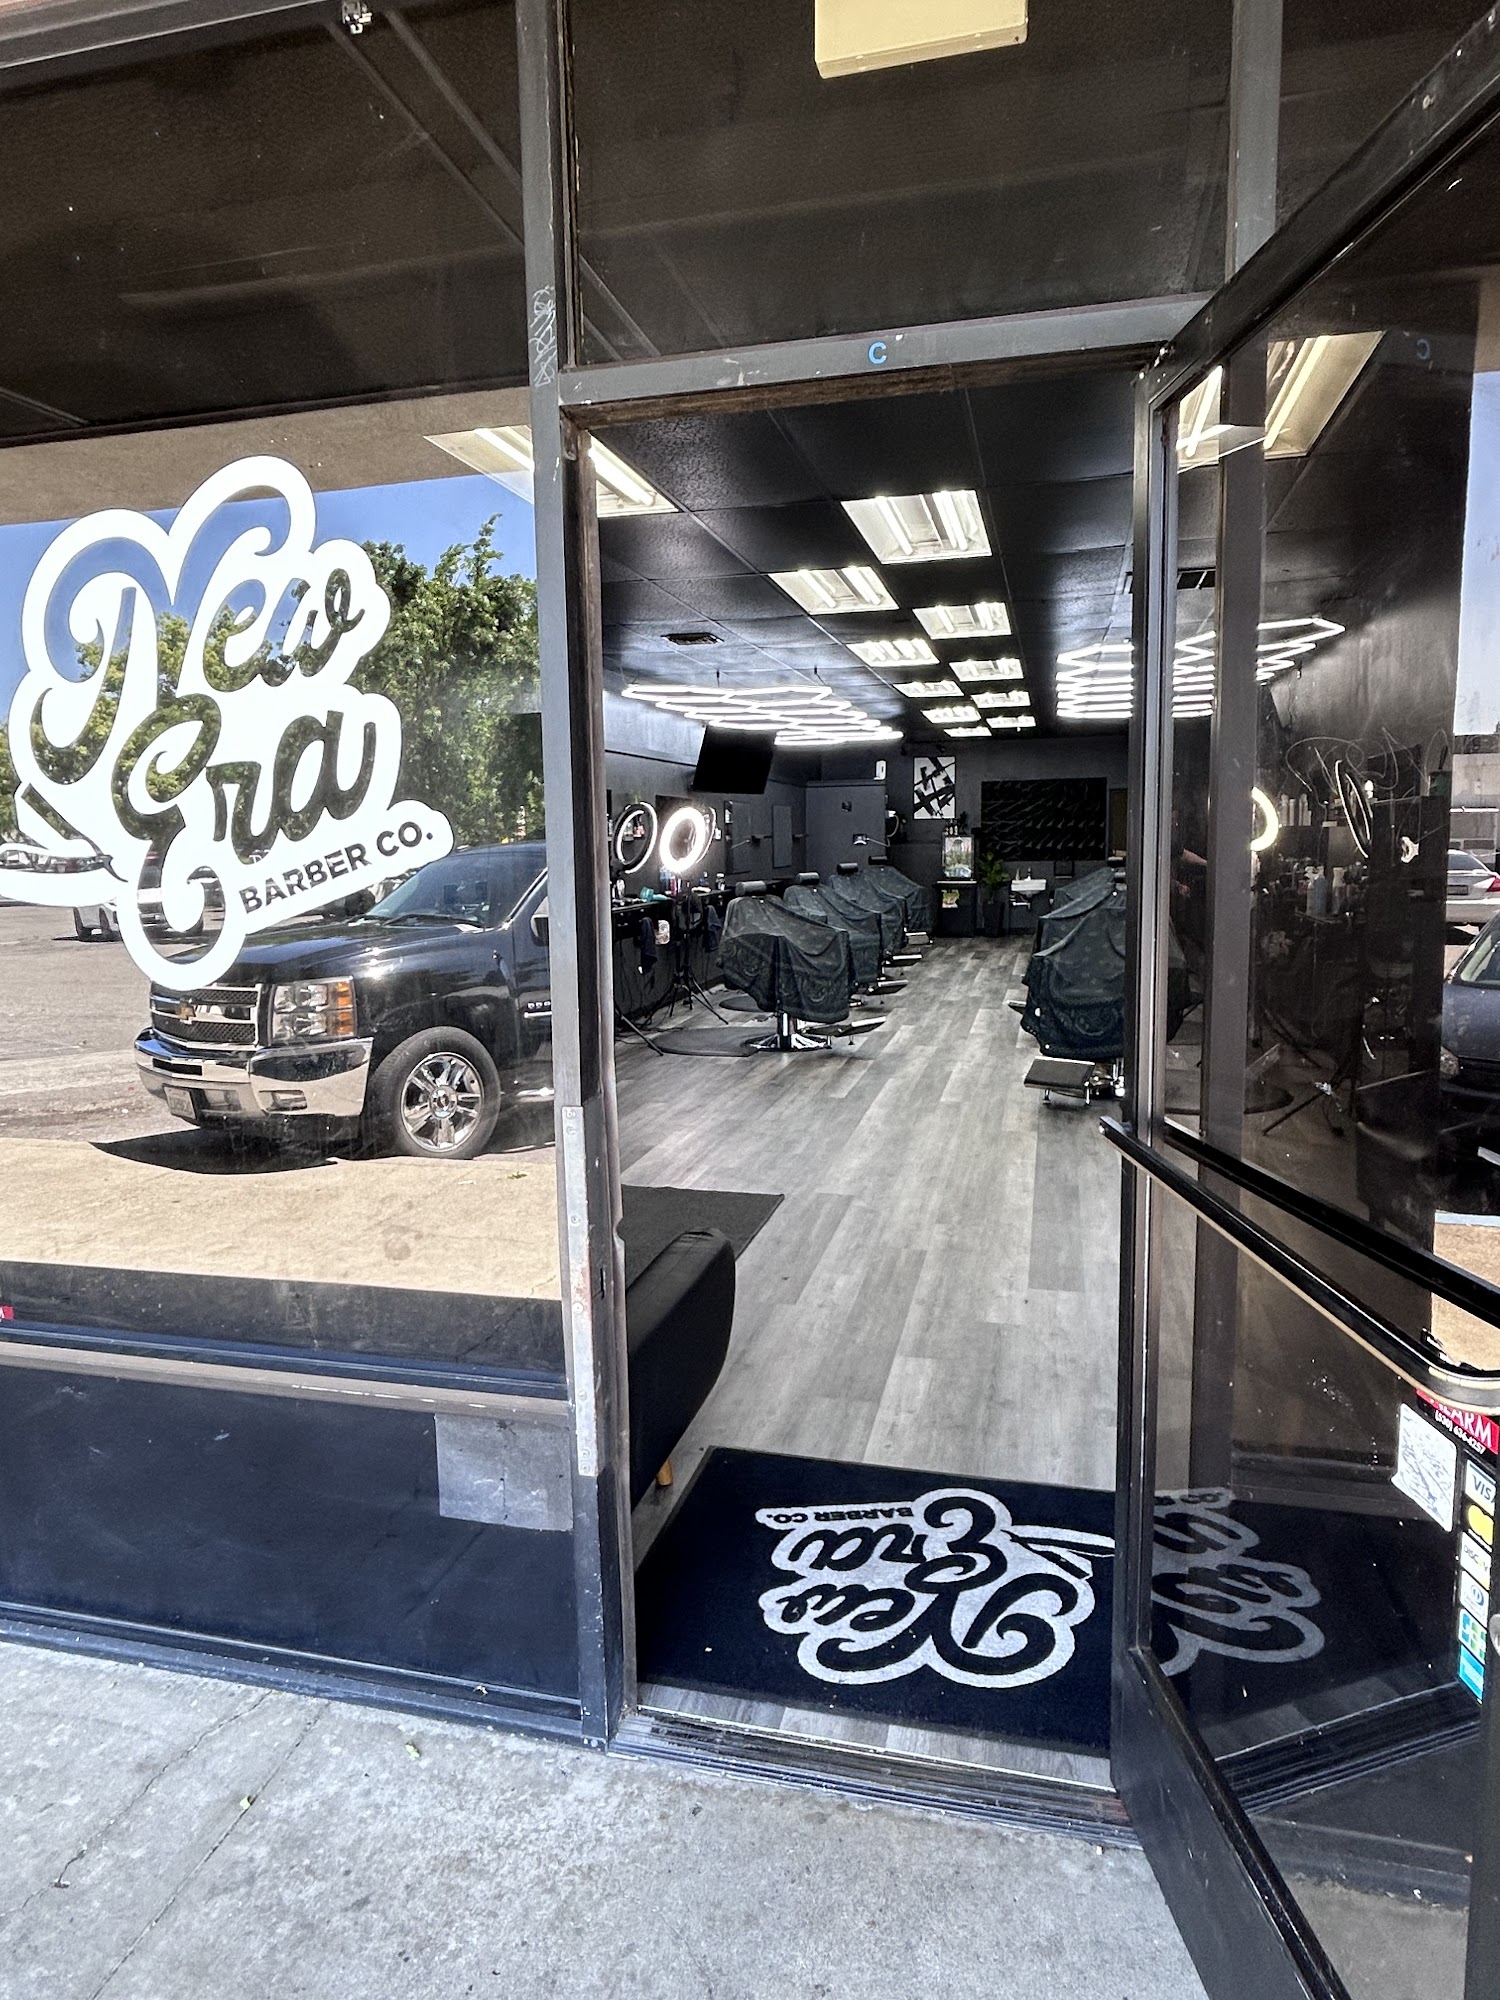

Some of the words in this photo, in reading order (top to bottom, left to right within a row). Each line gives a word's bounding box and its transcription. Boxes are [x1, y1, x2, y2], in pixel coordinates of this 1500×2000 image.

[868, 342, 887, 364] C
[30, 484, 366, 786] New
[111, 693, 377, 966] Era
[239, 843, 372, 914] BARBER
[376, 821, 434, 857] CO.
[767, 1511, 809, 1524] CO.
[788, 1496, 1007, 1594] Era
[814, 1507, 914, 1522] BARBER
[776, 1572, 1079, 1676] New
